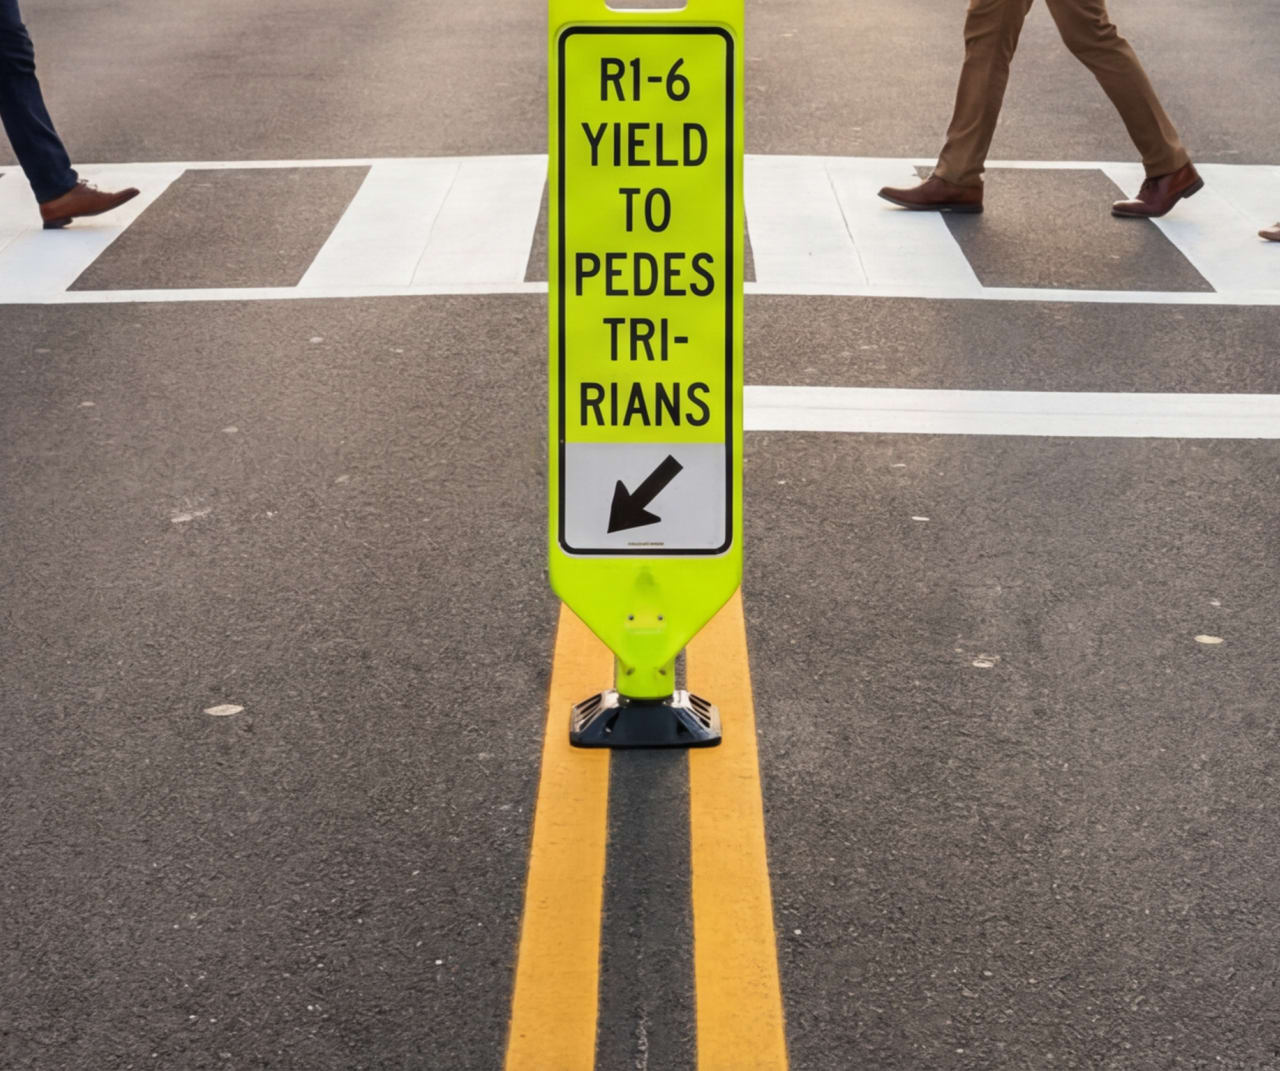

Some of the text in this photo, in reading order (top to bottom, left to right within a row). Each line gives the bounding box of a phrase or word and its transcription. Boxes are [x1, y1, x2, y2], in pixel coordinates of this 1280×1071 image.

[600, 57, 691, 102] R1-6
[581, 122, 708, 167] YIELD
[618, 187, 672, 233] TO
[575, 252, 715, 297] PEDES
[602, 317, 689, 361] TRI-
[580, 381, 711, 427] RIANS
